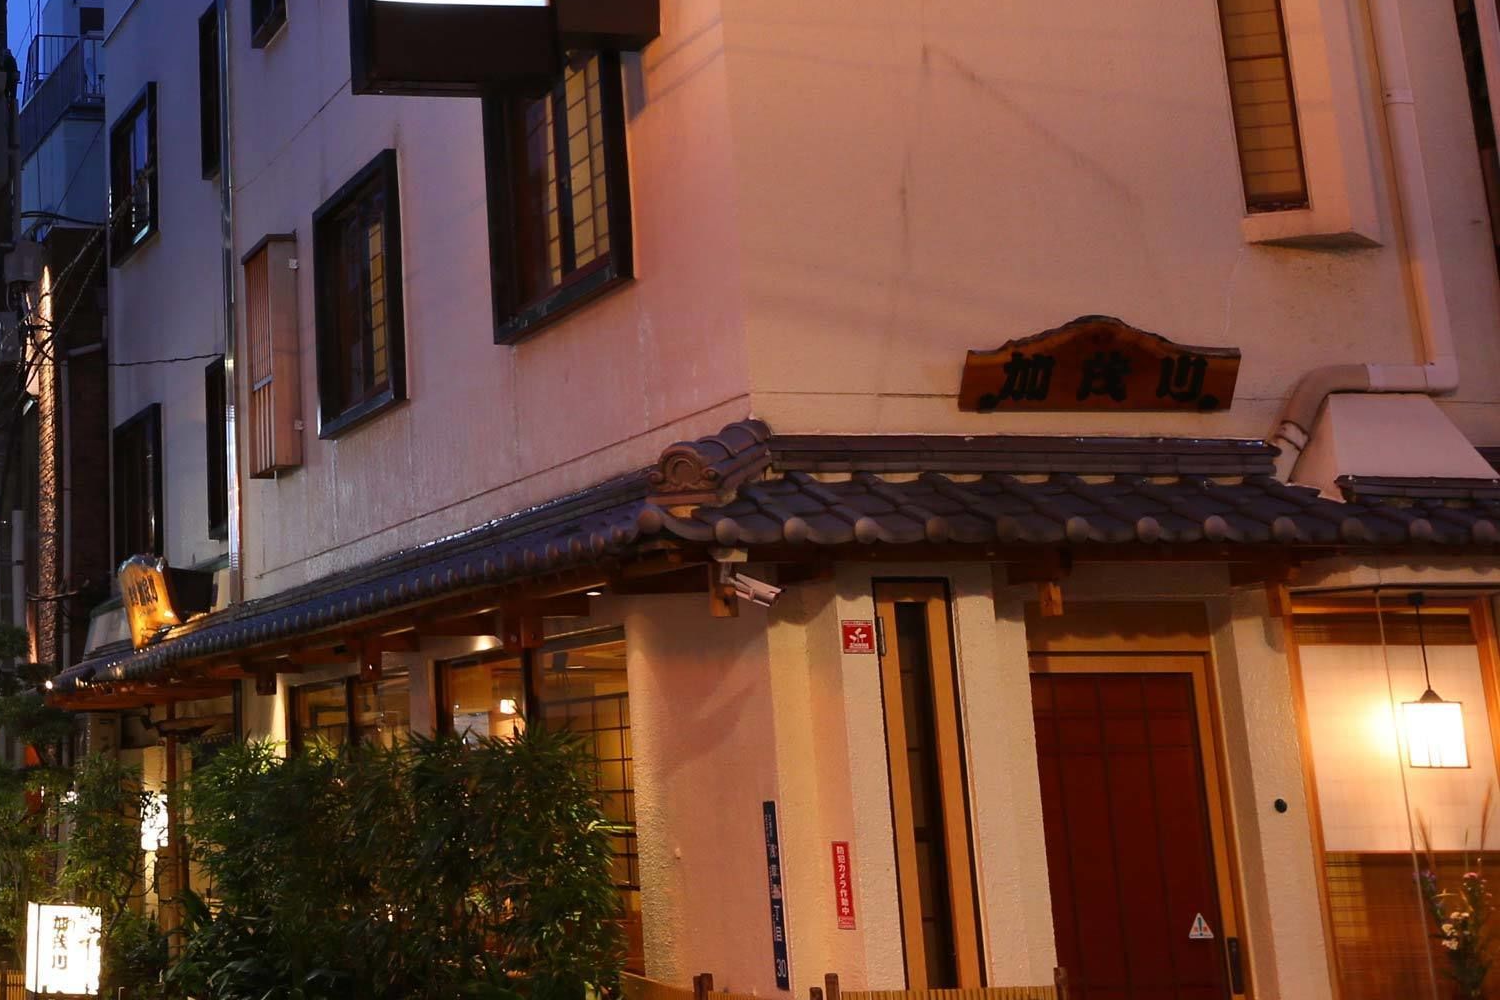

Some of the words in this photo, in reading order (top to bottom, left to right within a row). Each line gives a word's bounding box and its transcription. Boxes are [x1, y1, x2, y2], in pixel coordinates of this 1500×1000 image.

[1002, 351, 1208, 402] 加茂川
[836, 846, 850, 916] 防犯カメラ作動中
